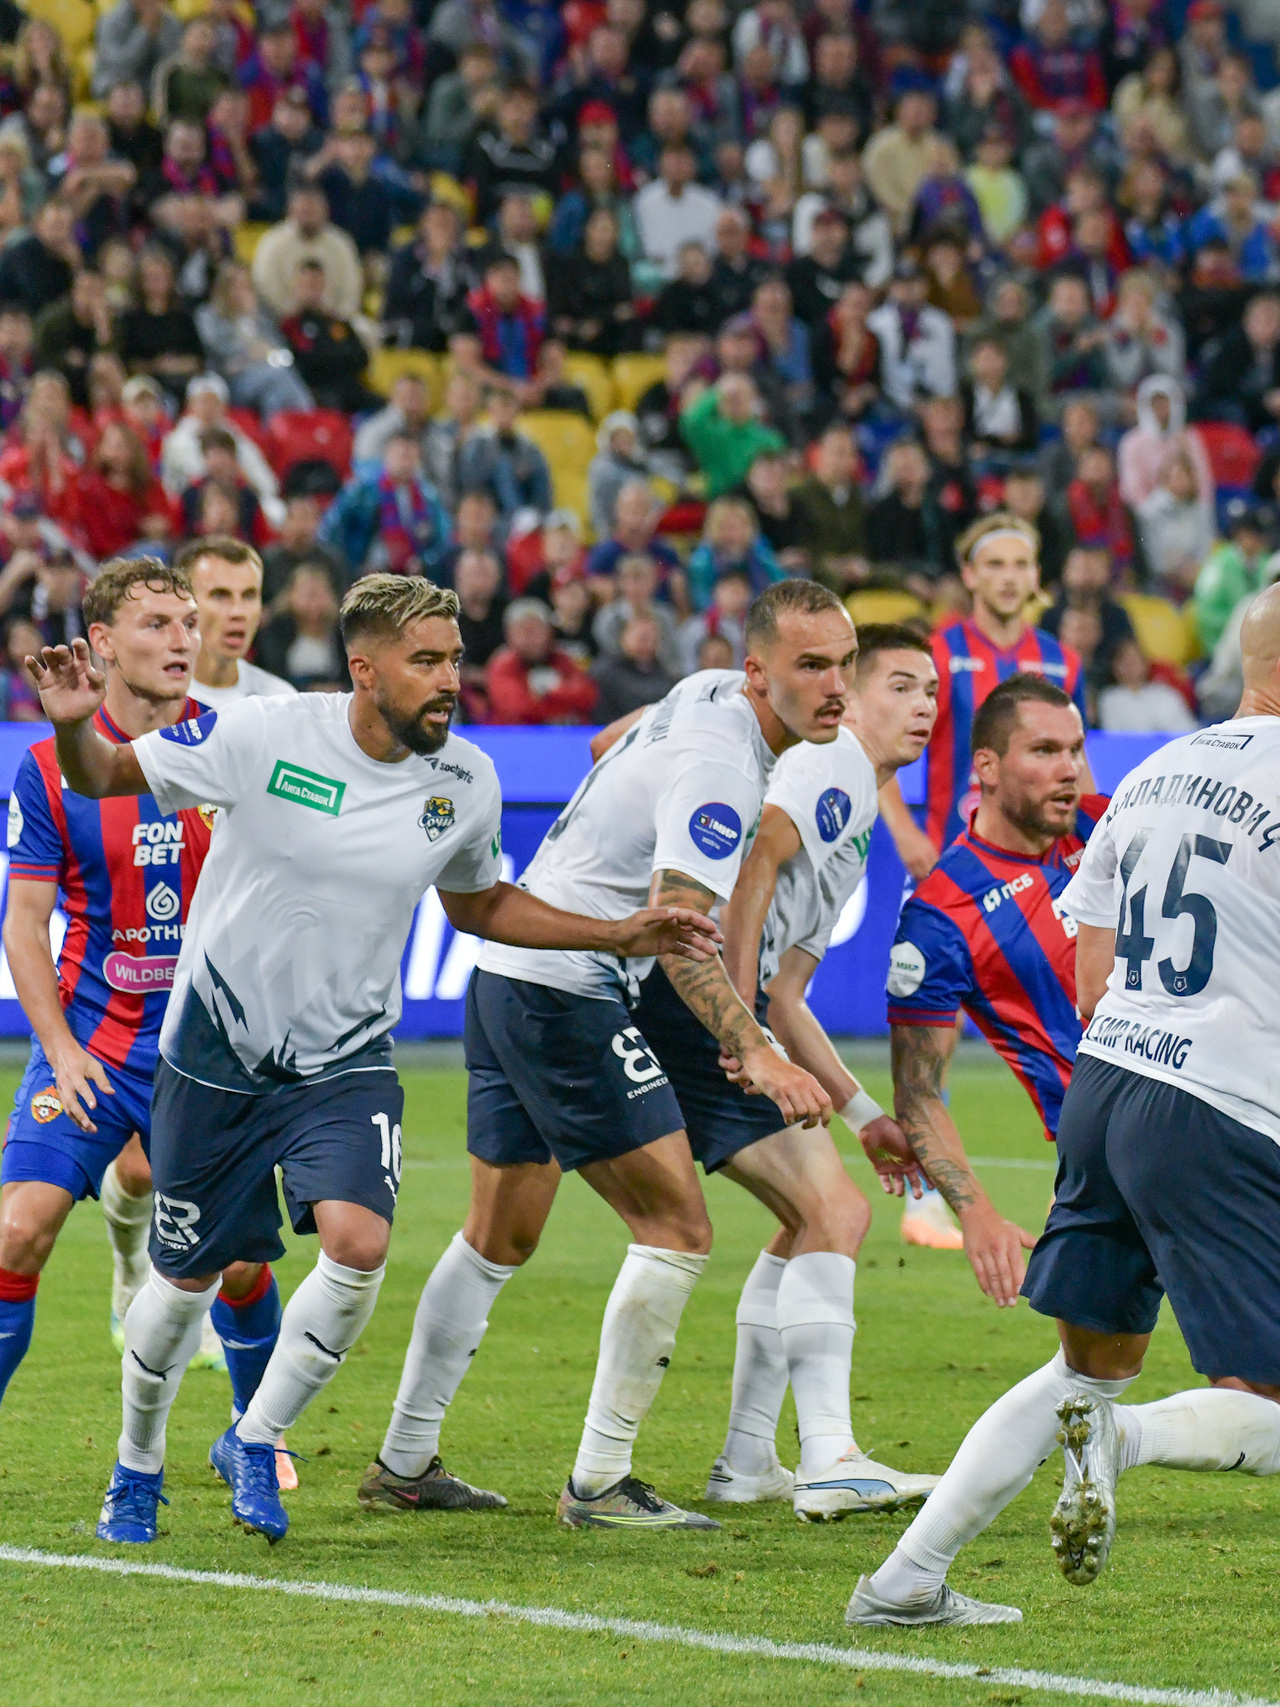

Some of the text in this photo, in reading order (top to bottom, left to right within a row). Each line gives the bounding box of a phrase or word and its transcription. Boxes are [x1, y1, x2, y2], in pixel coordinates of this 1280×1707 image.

[132, 821, 184, 845] FON
[133, 842, 186, 867] BET
[1001, 872, 1034, 900] ПСБ
[1115, 827, 1233, 997] 45
[1124, 1023, 1193, 1070] RACING
